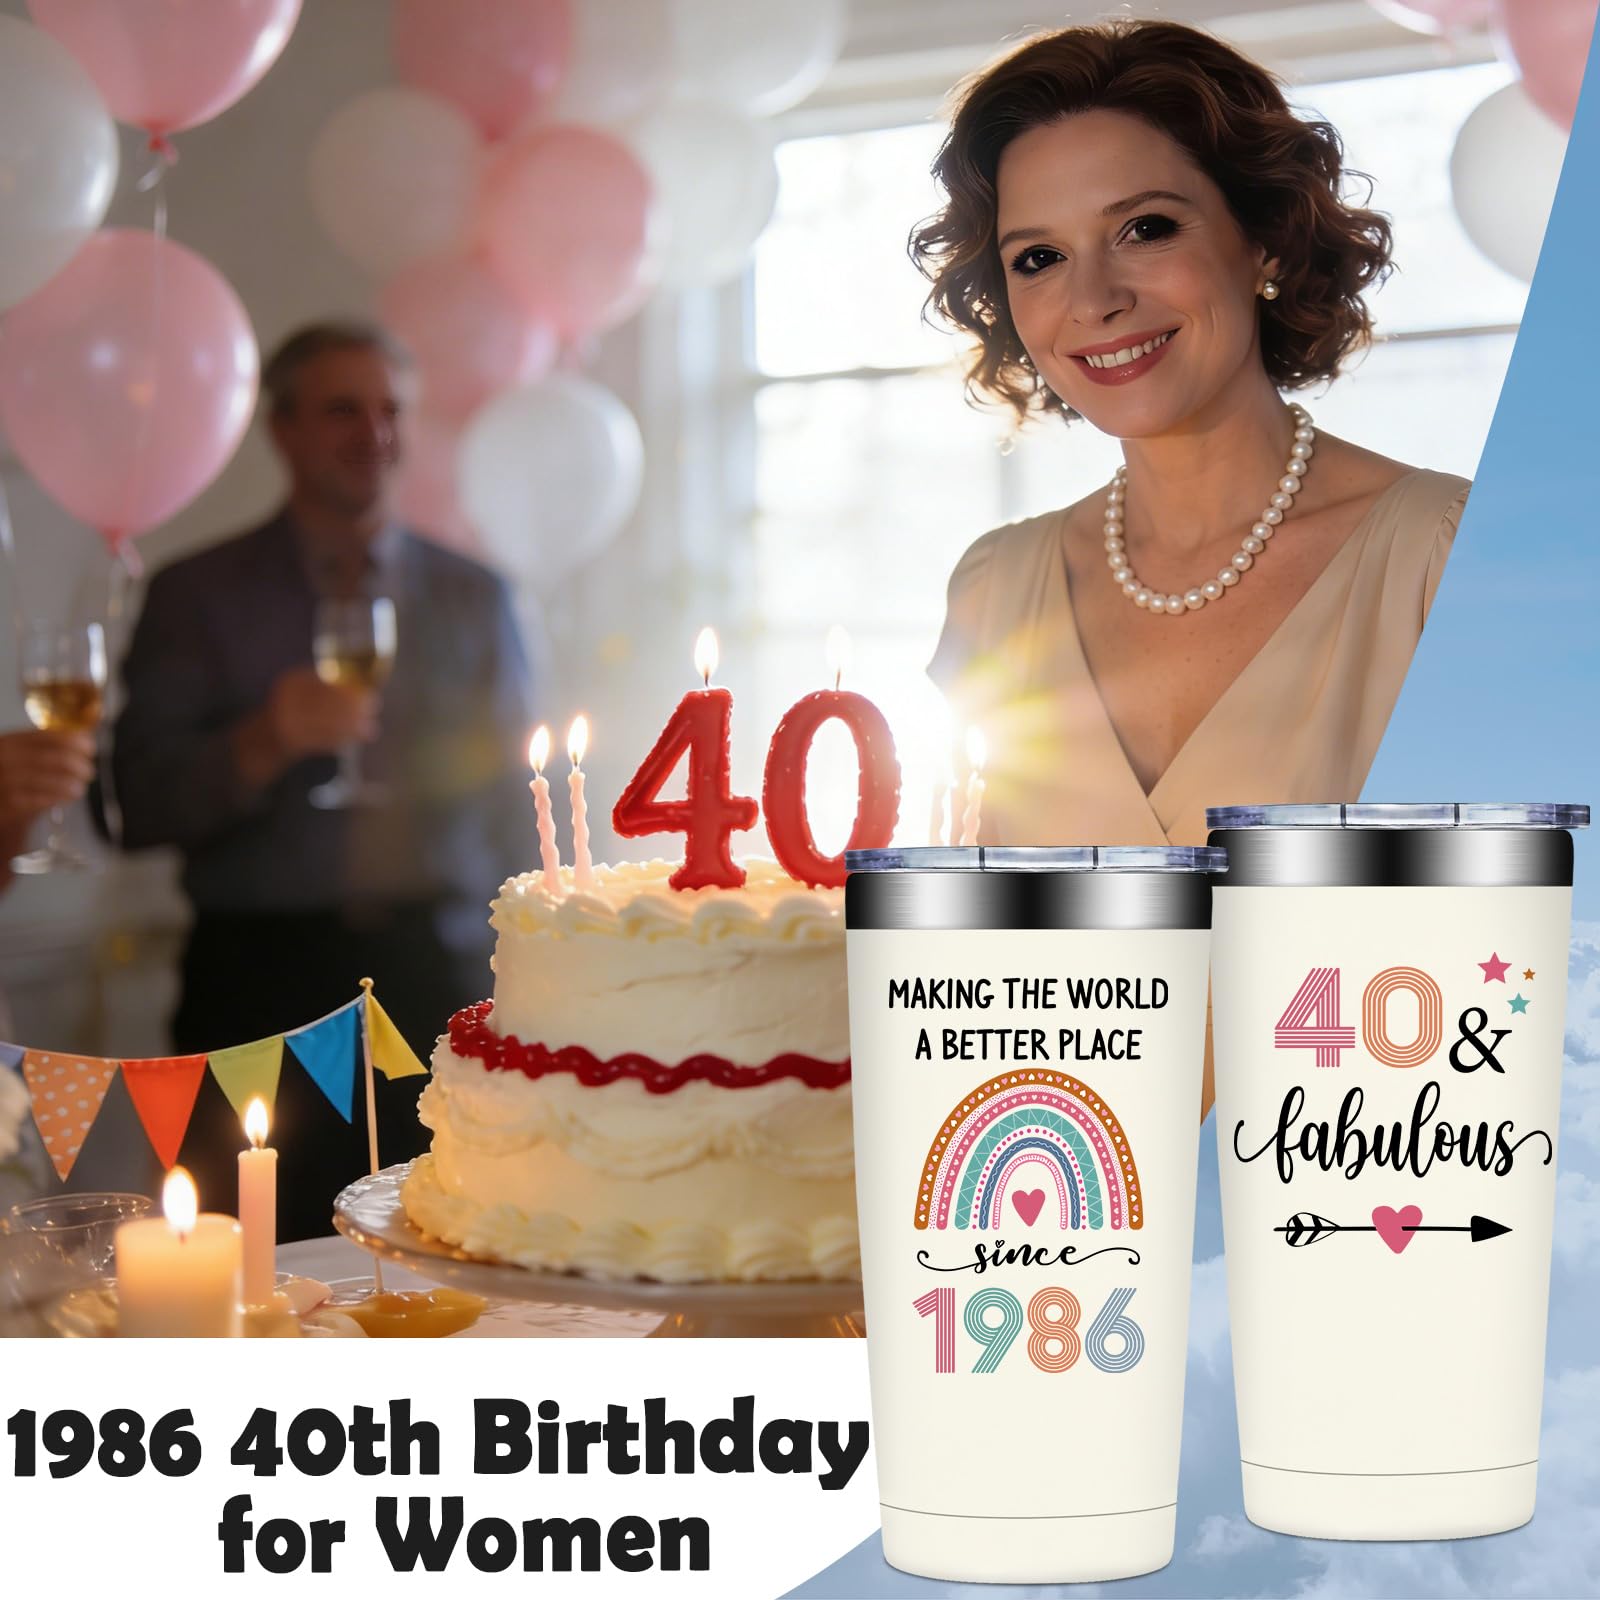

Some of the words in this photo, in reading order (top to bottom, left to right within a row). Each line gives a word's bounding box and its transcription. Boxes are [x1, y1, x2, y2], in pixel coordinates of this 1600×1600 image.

[612, 687, 902, 890] 40
[888, 977, 994, 1009] MAKING
[1002, 977, 1058, 1009] THE
[1067, 977, 1169, 1009] WORLD
[914, 1028, 931, 1060] A
[942, 1028, 1049, 1060] BETTER
[1059, 1028, 1142, 1060] PLACE
[1234, 1081, 1552, 1184] fabulous
[917, 1240, 1140, 1274] since
[912, 1286, 1145, 1374] 1986
